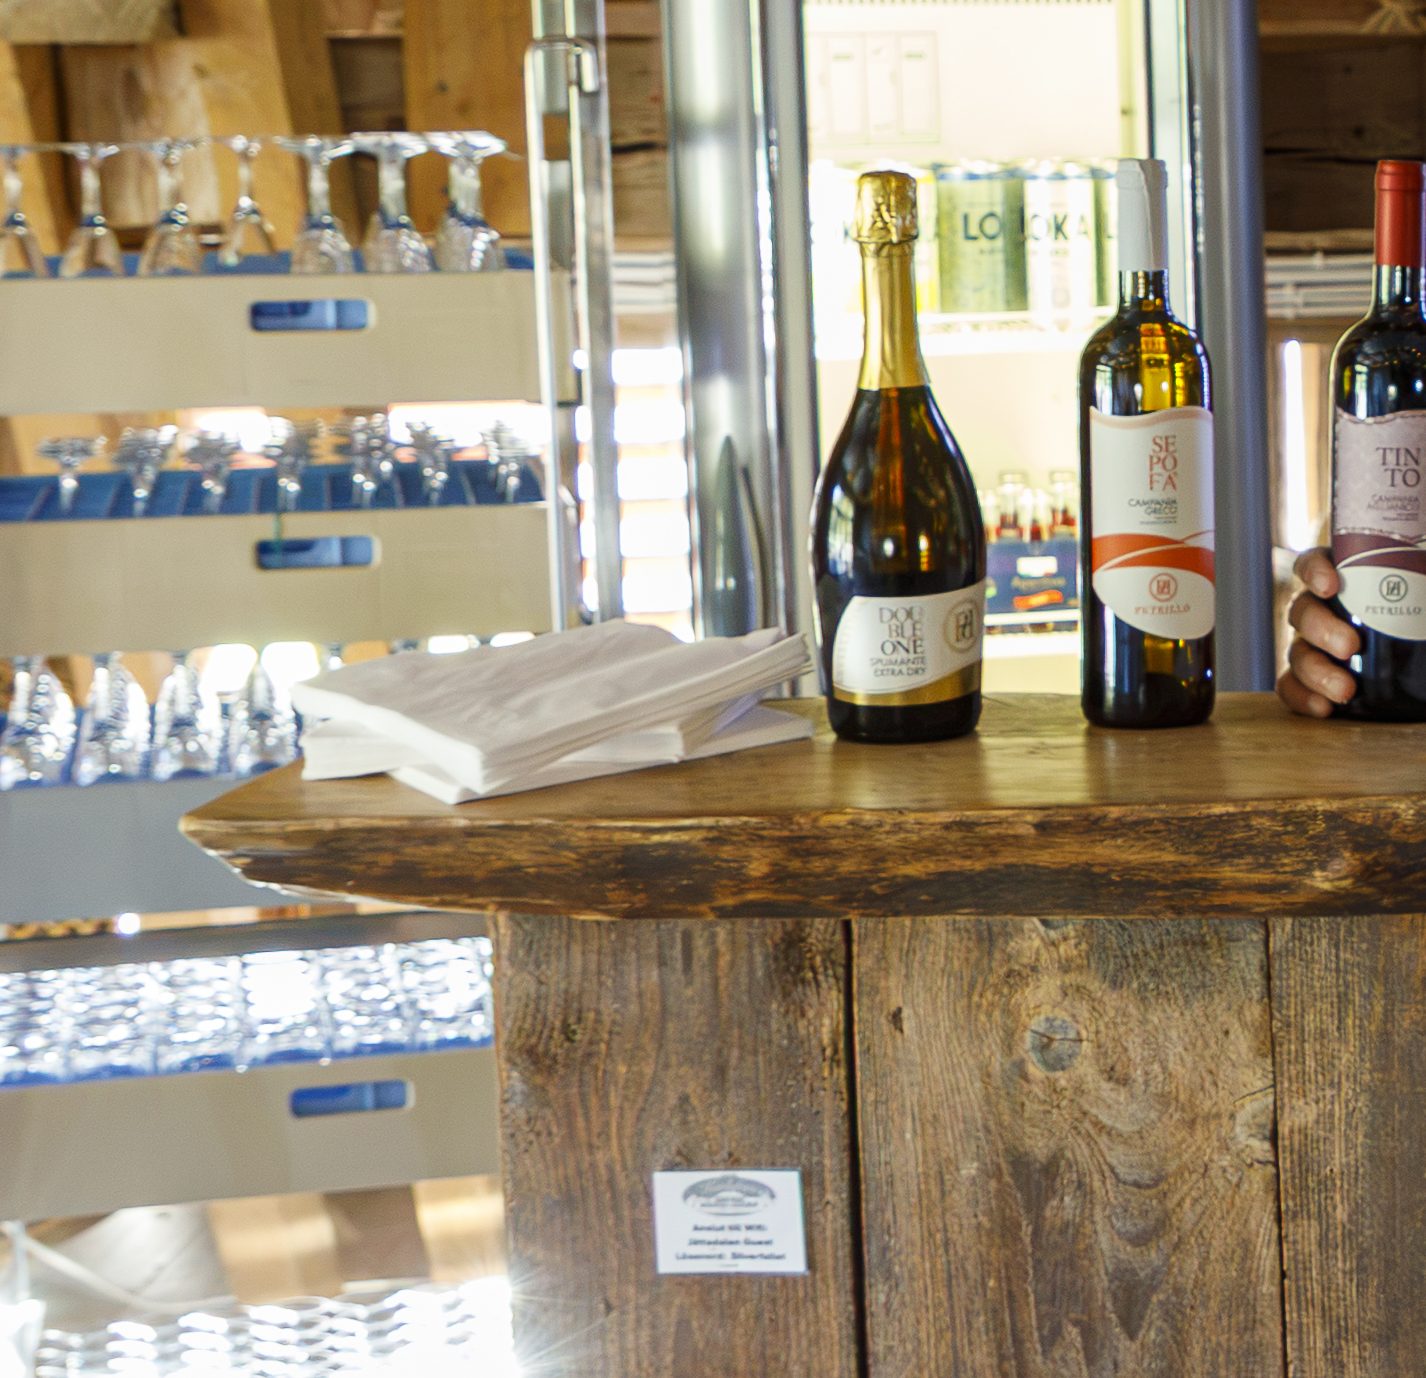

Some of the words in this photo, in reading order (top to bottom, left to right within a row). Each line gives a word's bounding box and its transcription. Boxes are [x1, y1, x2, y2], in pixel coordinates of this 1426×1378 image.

[1152, 434, 1178, 454] SE
[1149, 454, 1178, 473] PO
[1375, 446, 1422, 467] TIN
[1384, 467, 1422, 488] TO
[1134, 603, 1191, 615] PETRILLO
[1364, 605, 1422, 616] PETRILLO
[888, 622, 924, 639] BLE
[880, 638, 926, 656] ONE
